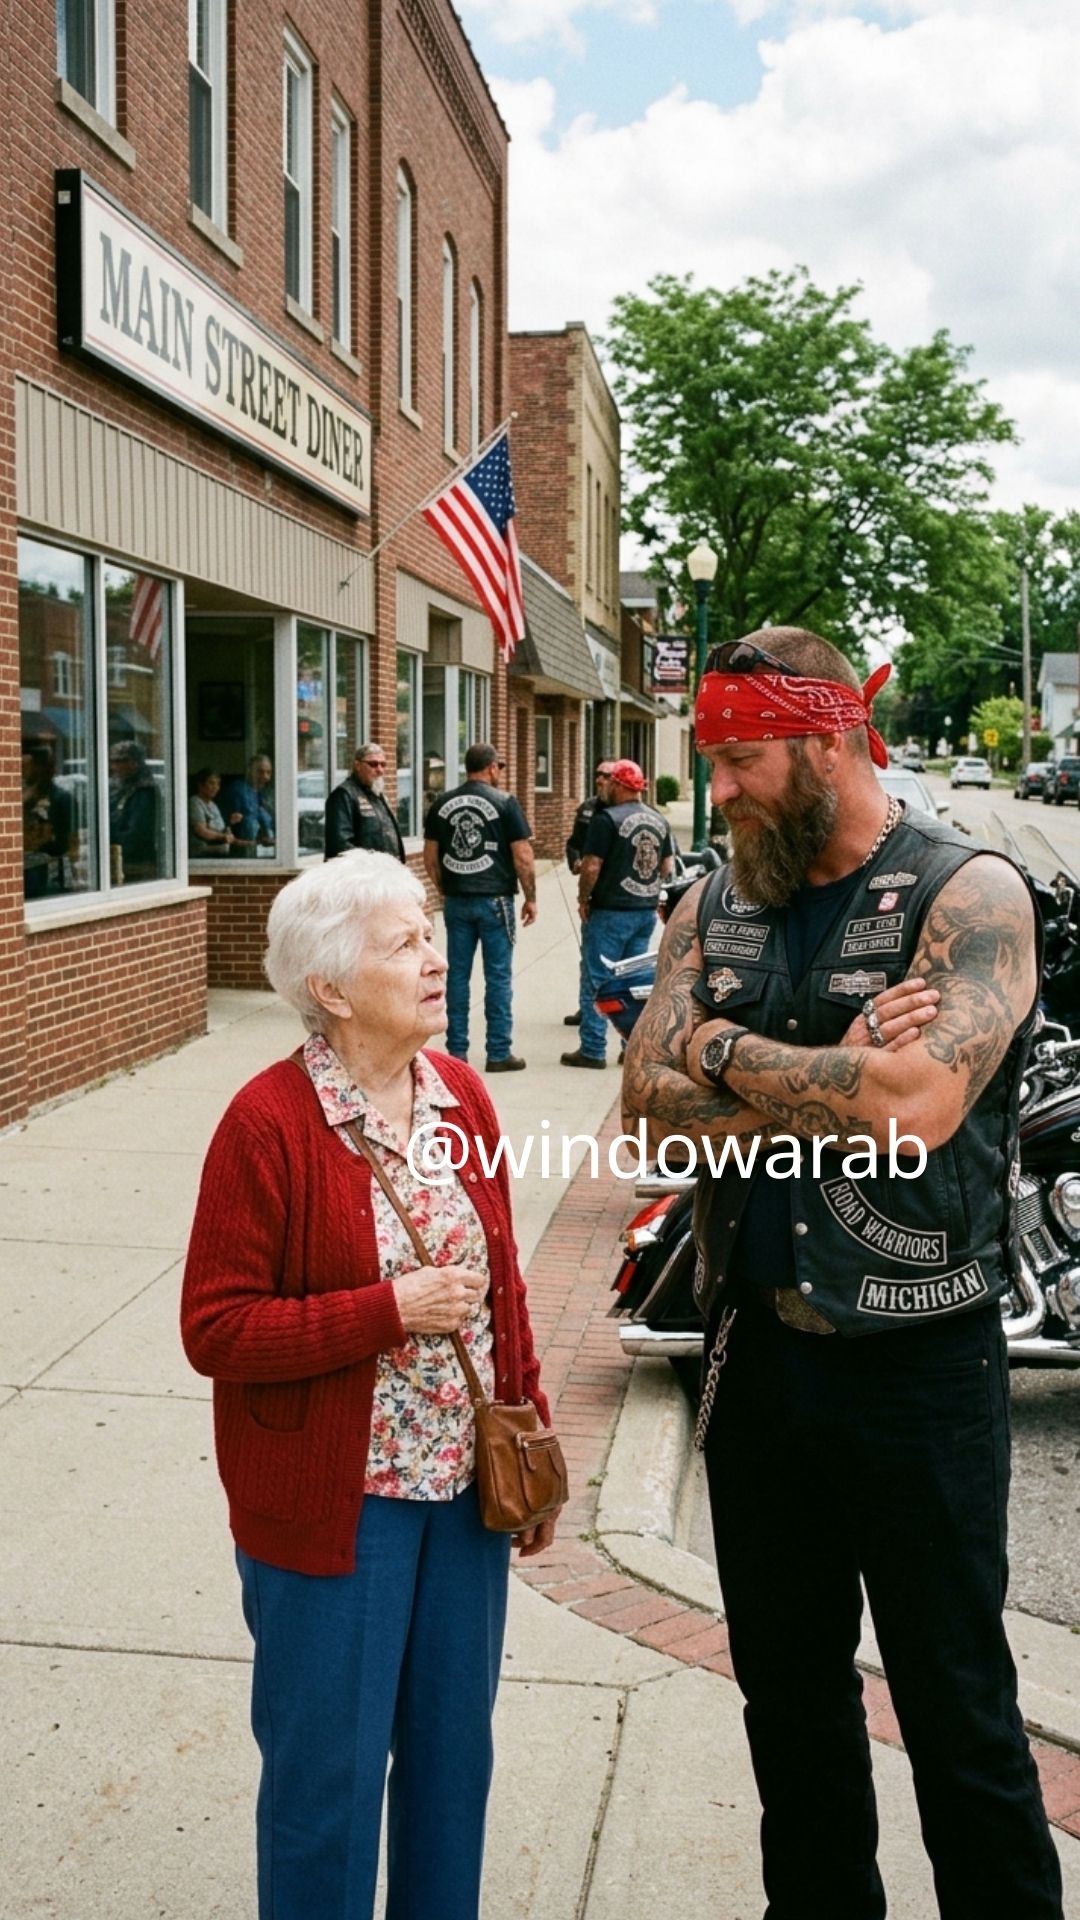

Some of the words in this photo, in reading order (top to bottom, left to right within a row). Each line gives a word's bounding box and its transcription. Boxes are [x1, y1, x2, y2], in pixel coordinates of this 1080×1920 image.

[100, 231, 194, 379] MAIN
[205, 314, 301, 447] STREET
[307, 393, 364, 491] DINER
[828, 1182, 866, 1226] ROAD
[861, 1215, 940, 1260] WARRIORS
[865, 1268, 982, 1311] MICHIGAN
